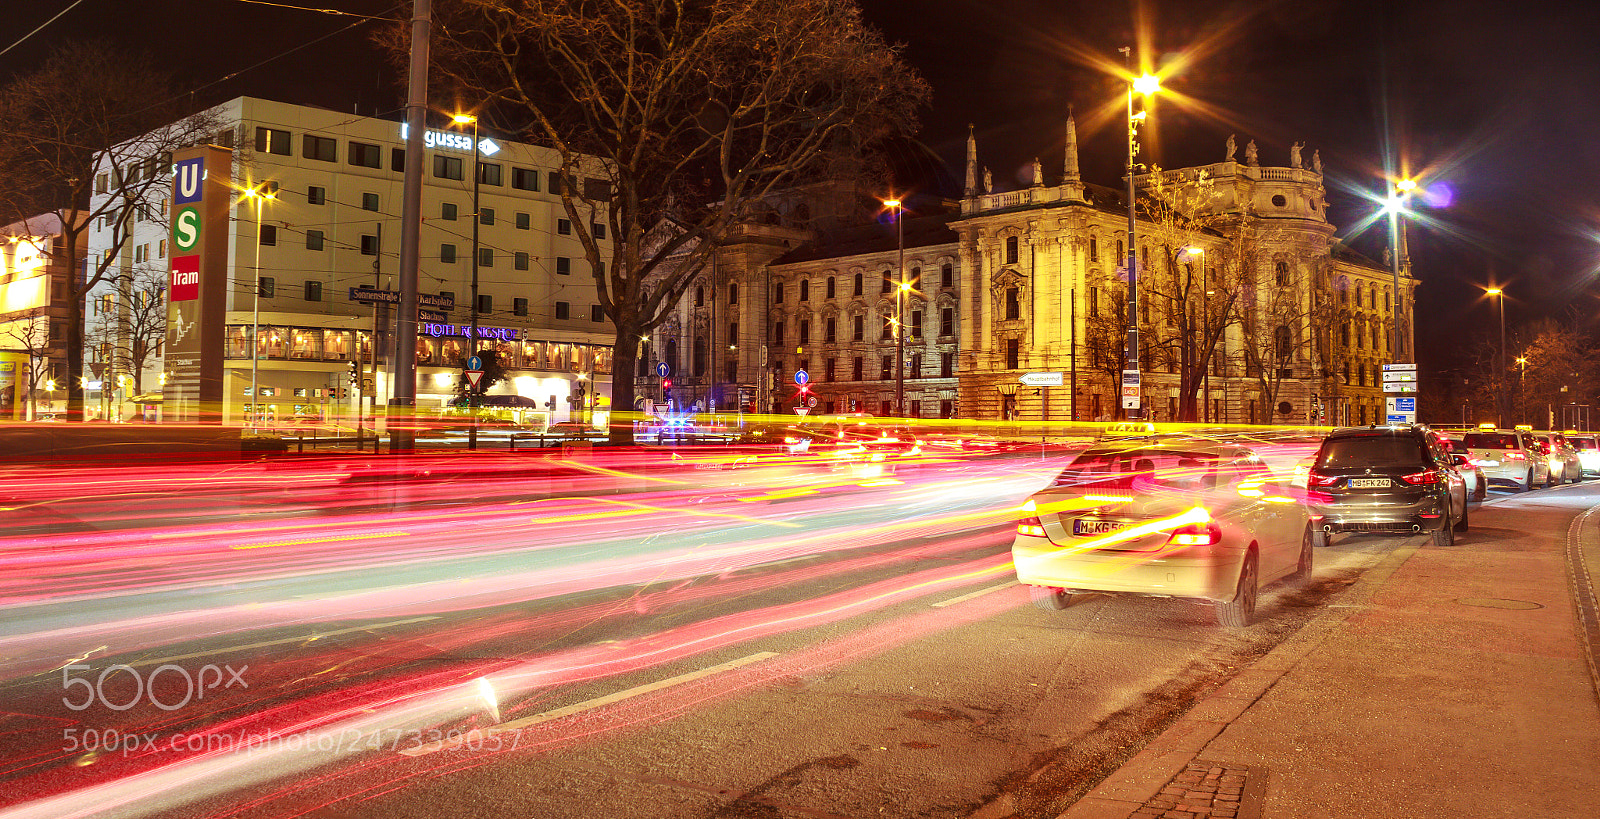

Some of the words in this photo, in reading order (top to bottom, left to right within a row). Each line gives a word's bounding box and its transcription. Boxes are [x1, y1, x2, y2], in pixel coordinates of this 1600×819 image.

[180, 163, 199, 198] U
[176, 210, 197, 248] S
[172, 269, 199, 286] Tram
[353, 289, 399, 302] Sonnenstraße
[419, 294, 454, 307] Karlsplatz
[419, 310, 445, 322] Stachus
[424, 323, 458, 338] HOTEL
[1112, 423, 1143, 432] TAXI
[1080, 521, 1089, 533] M
